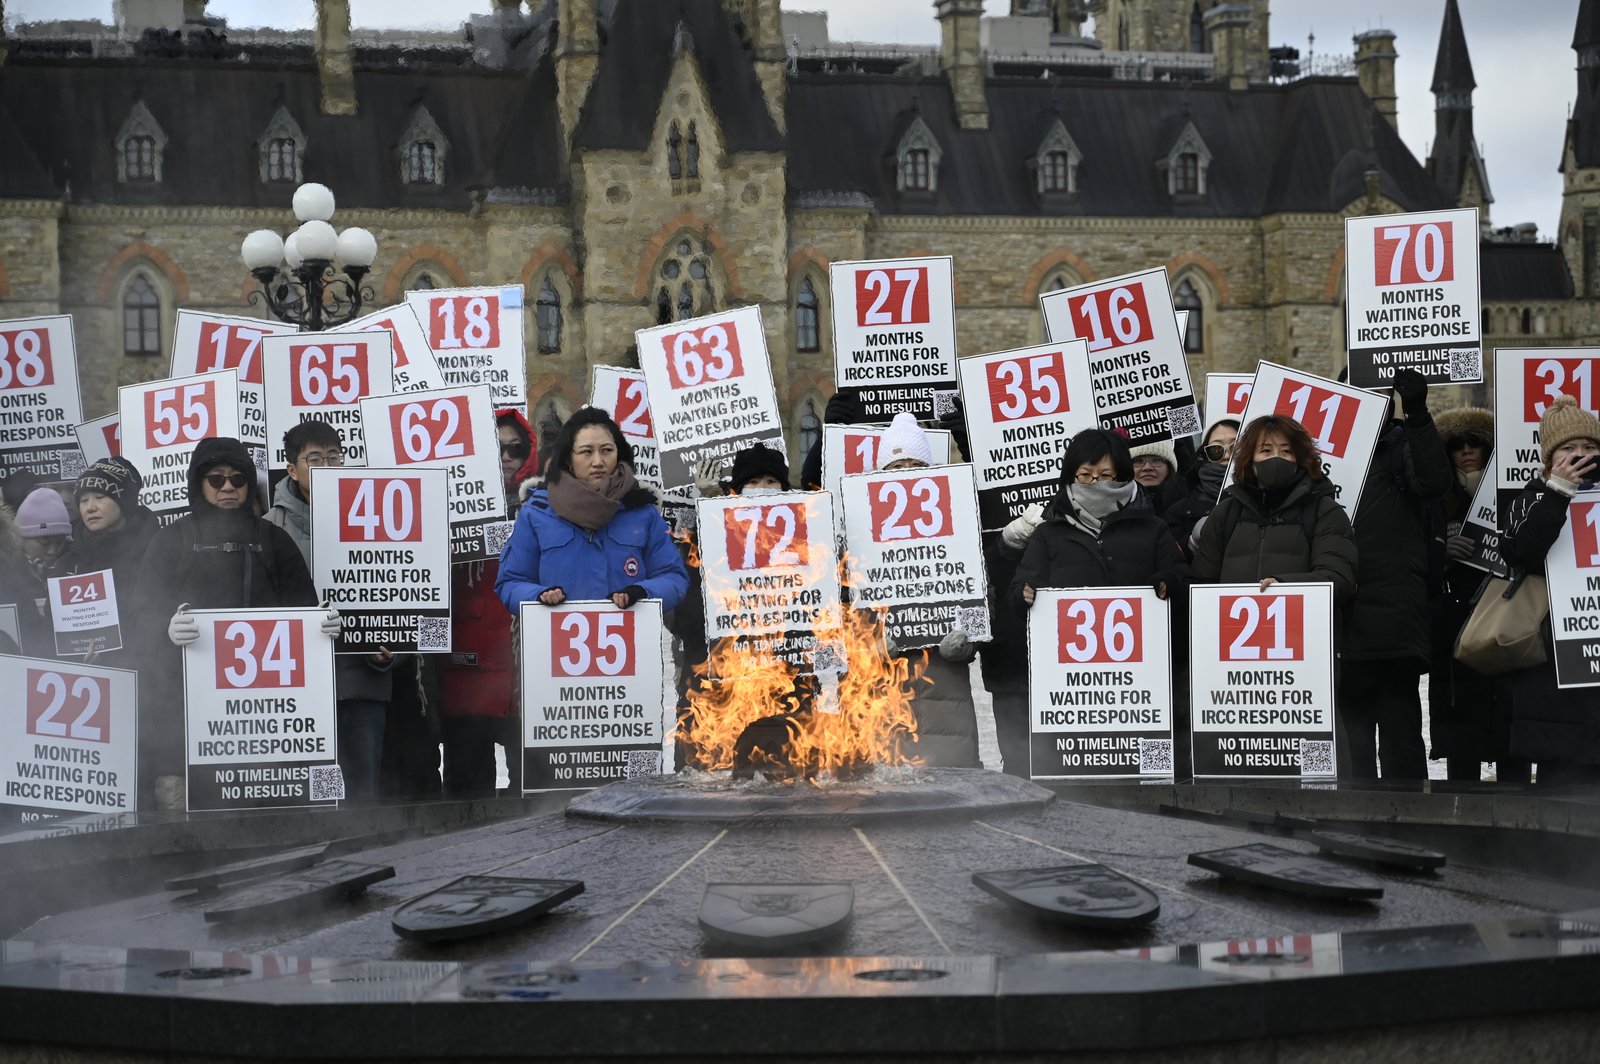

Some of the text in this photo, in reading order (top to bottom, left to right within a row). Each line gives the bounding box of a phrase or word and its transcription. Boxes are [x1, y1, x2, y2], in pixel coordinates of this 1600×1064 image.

[1384, 224, 1444, 283] 70
[864, 269, 919, 324] 27
[1382, 288, 1444, 304] MONTHS
[1080, 287, 1141, 351] 16
[1366, 304, 1461, 324] WAITING FOR
[438, 298, 490, 348] 18
[866, 332, 923, 347] MONTHS
[1358, 322, 1470, 342] IRCC RESPONSE
[208, 326, 262, 380] 17
[438, 355, 492, 368] MONTHS
[674, 326, 734, 385] 63
[853, 347, 939, 363] WAITING FOR
[1373, 352, 1390, 364] NO
[1091, 350, 1151, 375] MONTHS
[299, 346, 360, 404] 65
[483, 369, 509, 382] FOR
[845, 363, 948, 380] IRCC RESPONSE
[1094, 363, 1170, 392] AITING FOR
[1378, 366, 1395, 378] NO
[681, 384, 741, 406] MONTHS
[859, 388, 935, 401] NO TIMELINES
[995, 356, 1060, 419] 35
[1108, 379, 1182, 406] RESPONSE
[1534, 359, 1600, 422] 31
[0, 392, 47, 409] ONTHS
[865, 402, 931, 414] NO RESULTS
[38, 408, 64, 421] FOR
[152, 383, 209, 445] 55
[300, 410, 360, 423] MONTHS
[669, 396, 759, 425] WAITING FOR
[1290, 384, 1342, 452] 11
[1, 424, 75, 442] RESPONSE
[401, 399, 464, 461] 62
[664, 411, 770, 444] IRCC RESPONSE
[1003, 421, 1064, 443] MONTHS
[1127, 421, 1170, 439] ESULTS
[3, 450, 61, 464] TIMELINES
[680, 451, 696, 463] NO
[990, 438, 1073, 462] WAITING FO
[984, 458, 1063, 482] IRCC RESPO
[456, 480, 485, 496] FOR
[1002, 490, 1018, 503] NO
[348, 479, 413, 541] 40
[879, 478, 943, 541] 23
[1009, 504, 1025, 517] NO
[735, 505, 799, 569] 72
[1481, 533, 1499, 549] NO
[349, 550, 414, 564] MONTHS
[882, 545, 947, 563] MONTHS
[332, 569, 431, 583] WAITING FOR
[867, 562, 965, 582] WAITING FOR
[739, 574, 803, 591] MONTHS
[860, 578, 975, 601] IRCC RESPONSE
[68, 582, 98, 603] 24
[322, 588, 440, 602] IRCC RESPONSE
[724, 589, 822, 611] WAITING FOR
[62, 613, 83, 622] WAITING
[72, 620, 100, 628] RESPONSE
[340, 616, 355, 627] NO
[716, 609, 833, 629] IRCC RESPONSE
[1563, 616, 1599, 633] IRCC
[1066, 599, 1134, 662] 36
[1229, 596, 1294, 660] 21
[344, 631, 418, 643] NO RESULTS
[560, 612, 627, 676] 35
[224, 621, 296, 688] 34
[1583, 644, 1600, 657] NO
[1066, 671, 1133, 686] MONTHS
[1227, 671, 1294, 685] MONTHS
[560, 685, 626, 701] MONTHS
[1050, 690, 1151, 705] WAITING FOR
[1211, 690, 1313, 705] WAITING FOR
[36, 672, 101, 741] 22
[226, 698, 297, 715] MONTHS
[543, 704, 643, 720] WAITING FOR
[1040, 709, 1161, 725] IRCC RESPONSE
[1202, 710, 1322, 724] IRCC RESPONSE
[208, 717, 315, 736] WAITING FOR
[533, 722, 653, 739] IRCC RESPONSE
[198, 737, 325, 756] IRCC RESPONSE
[1057, 739, 1075, 750] NO
[1218, 738, 1236, 750] NO
[34, 744, 100, 765] MONTHS
[550, 751, 629, 764] NO TIMELINE
[1063, 754, 1139, 766] NO RESULTS
[1224, 754, 1301, 766] NO RESULTS
[16, 762, 118, 787] WAITING FOR
[215, 767, 309, 783] NO TIMELINES
[555, 766, 629, 779] NO RESULTS
[5, 781, 126, 808] IRCC RESPONSE
[221, 784, 303, 799] NO RESULTS
